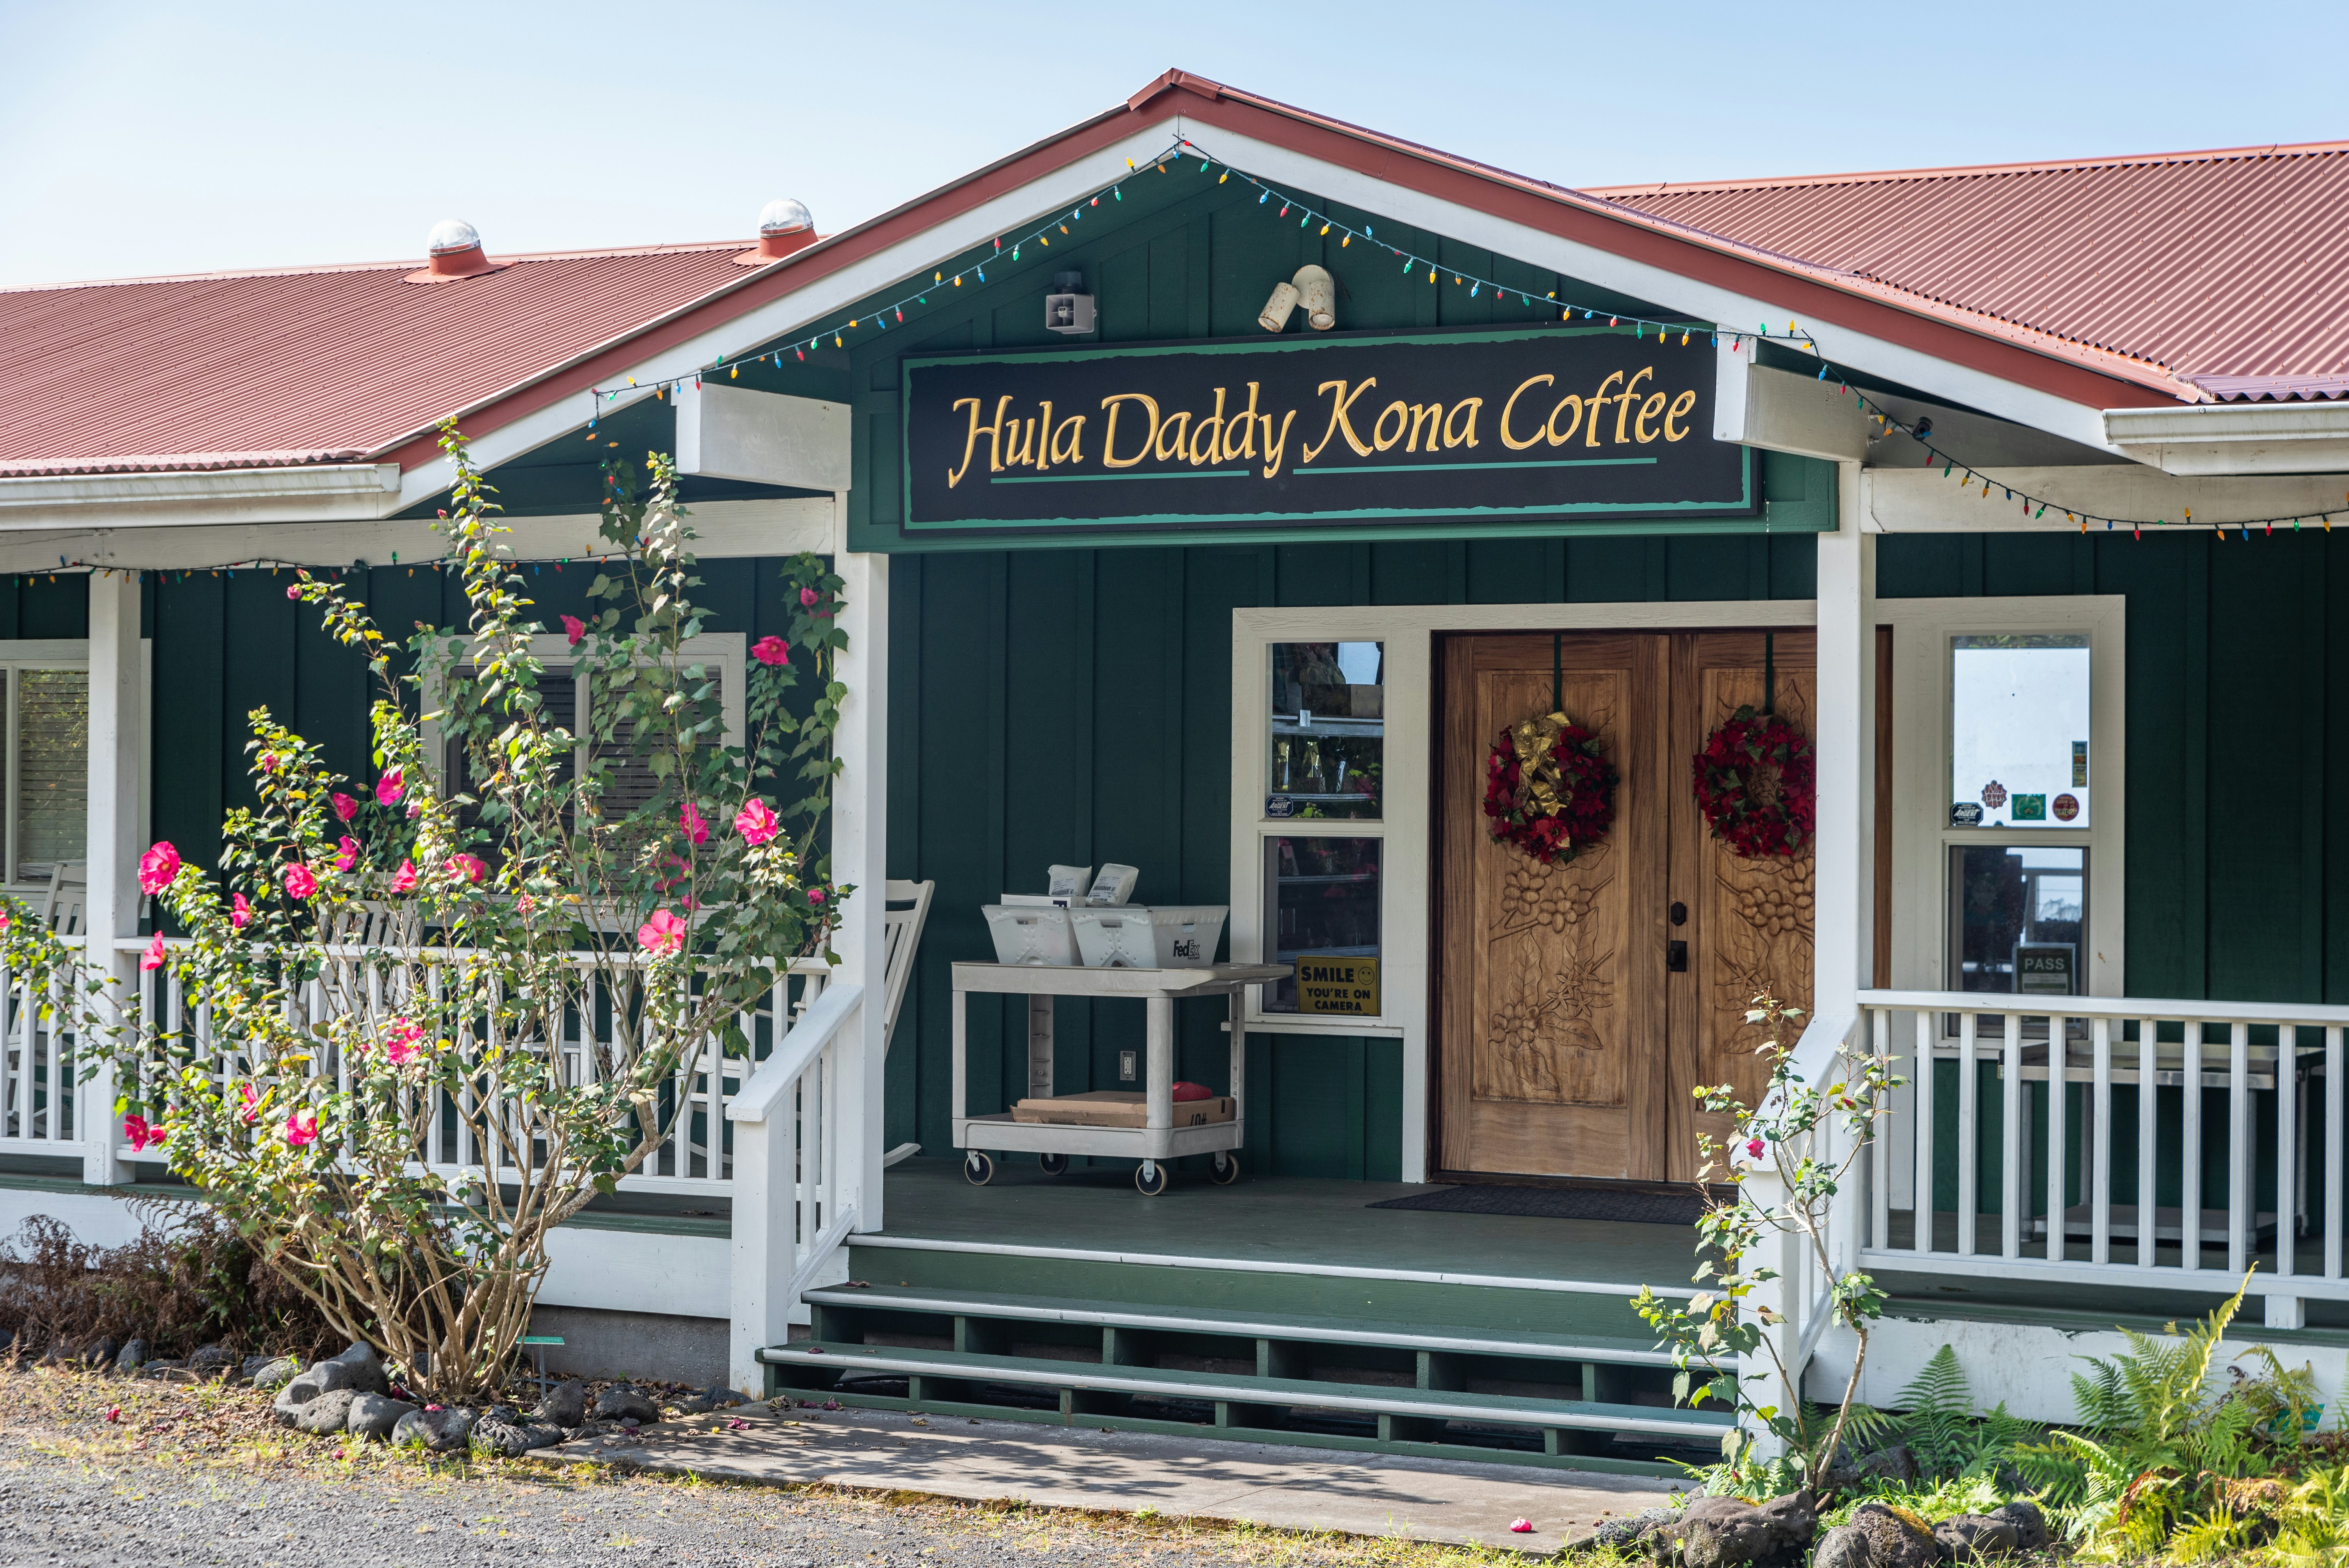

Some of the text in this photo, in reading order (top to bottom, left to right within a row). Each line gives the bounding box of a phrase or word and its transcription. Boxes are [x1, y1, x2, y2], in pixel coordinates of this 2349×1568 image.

[949, 366, 1696, 488] Hula Daddy Kona Coffee
[1173, 939, 1200, 957] FedEx
[2024, 958, 2064, 970] PASS
[1301, 966, 1355, 983] SMILE
[1306, 987, 1371, 999] YOU'RE ON
[1314, 1000, 1362, 1011] CAMERA
